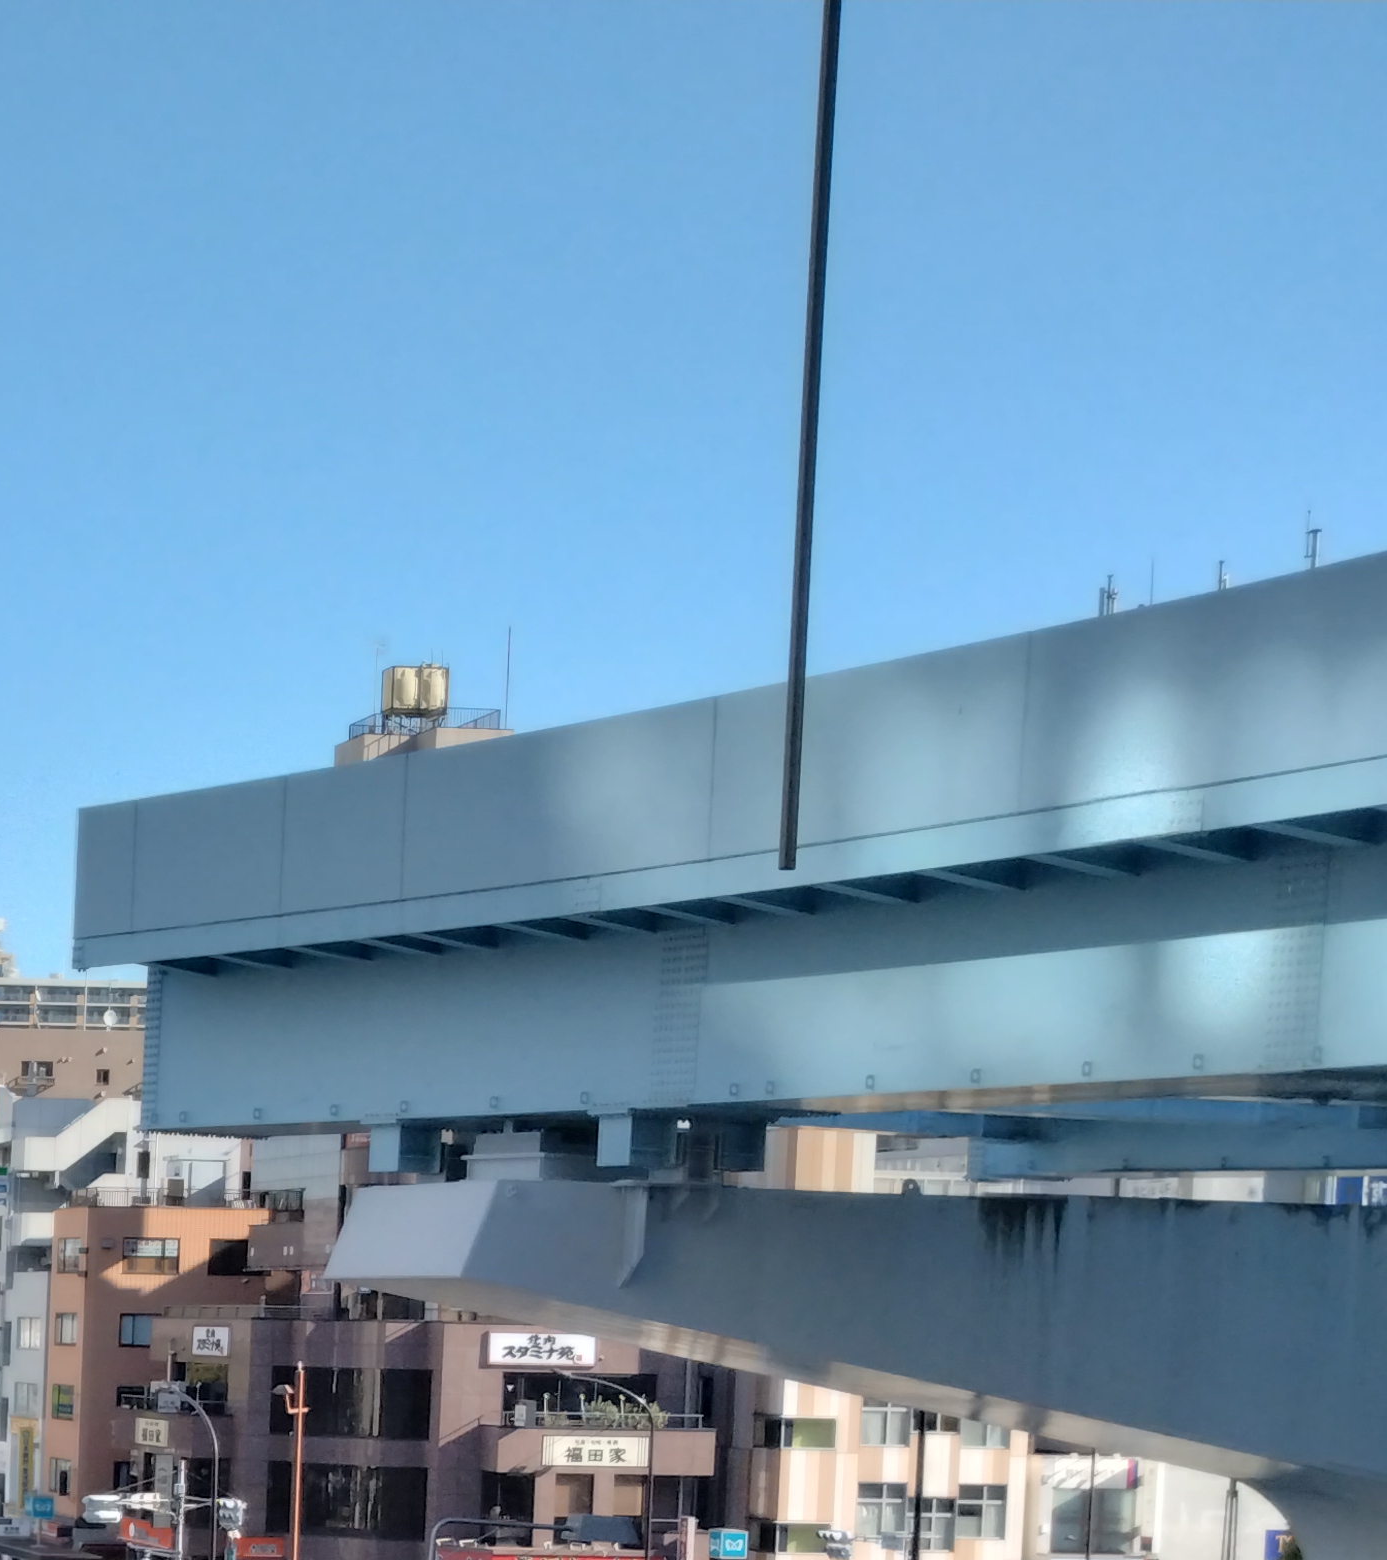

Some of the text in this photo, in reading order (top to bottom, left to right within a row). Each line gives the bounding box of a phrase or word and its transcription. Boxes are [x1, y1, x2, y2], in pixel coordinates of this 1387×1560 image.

[502, 1346, 576, 1361] スタミナ苑
[564, 1446, 626, 1464] 福田家
